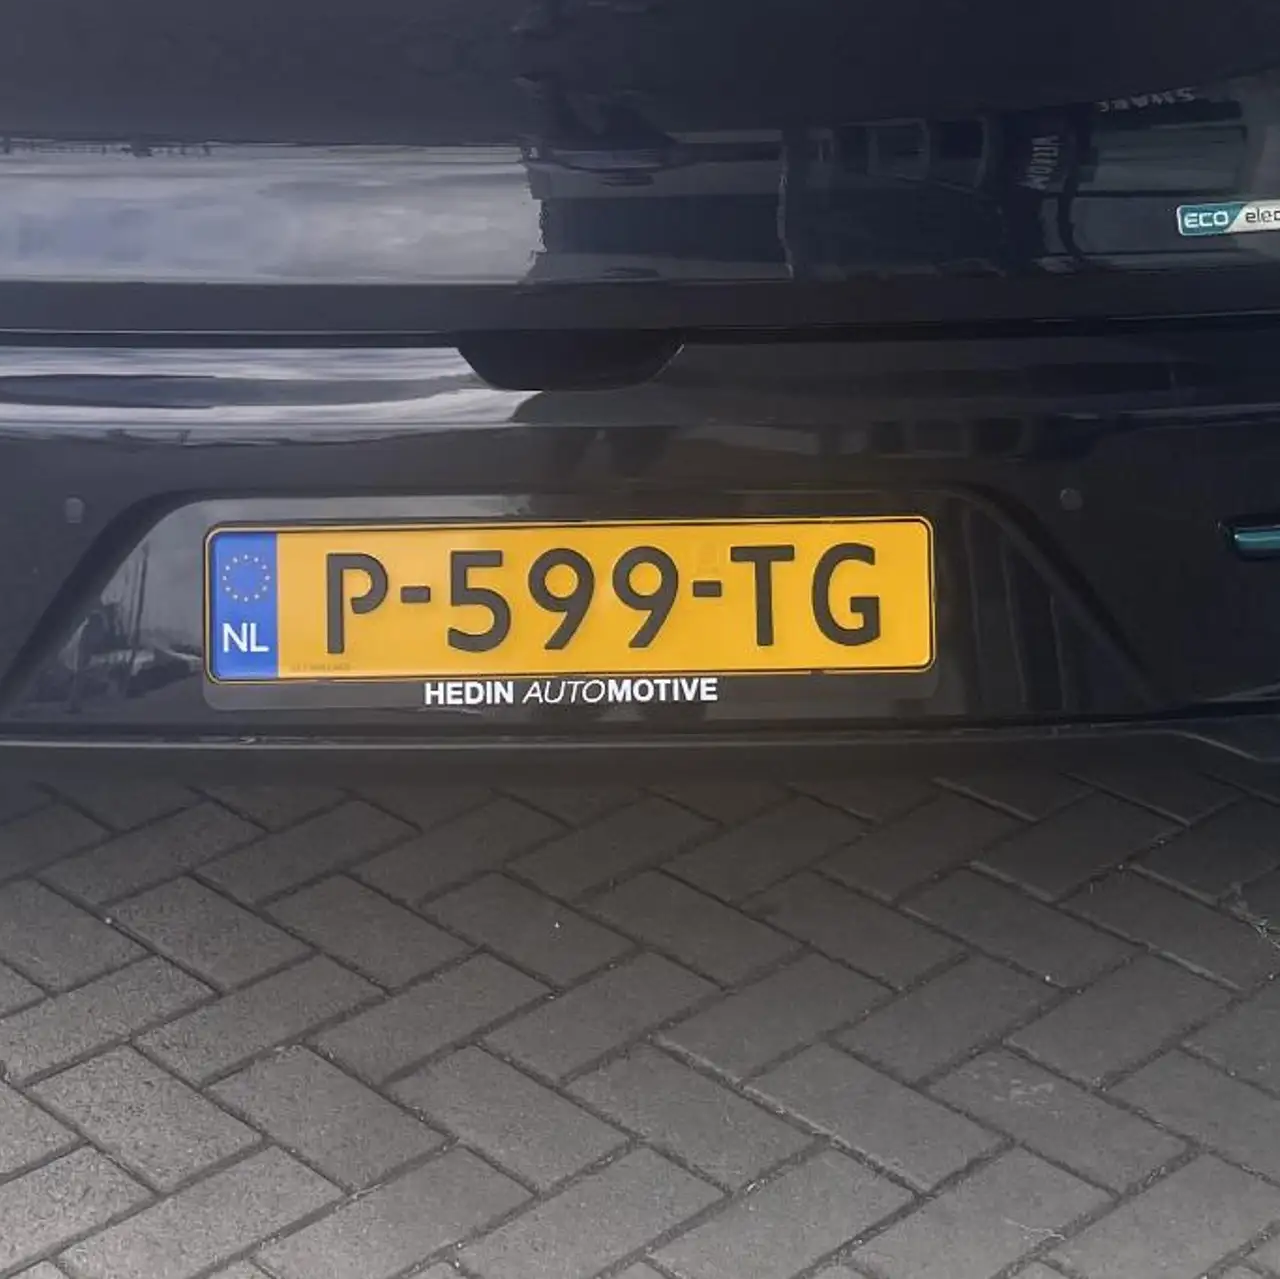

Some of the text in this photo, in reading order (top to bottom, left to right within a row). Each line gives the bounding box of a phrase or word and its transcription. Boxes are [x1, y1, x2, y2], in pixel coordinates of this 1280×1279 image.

[1183, 210, 1230, 229] ECO
[325, 542, 882, 655] P-599-TG
[222, 623, 269, 654] NL
[424, 677, 718, 705] HEDIN AUTOMOTIVE
